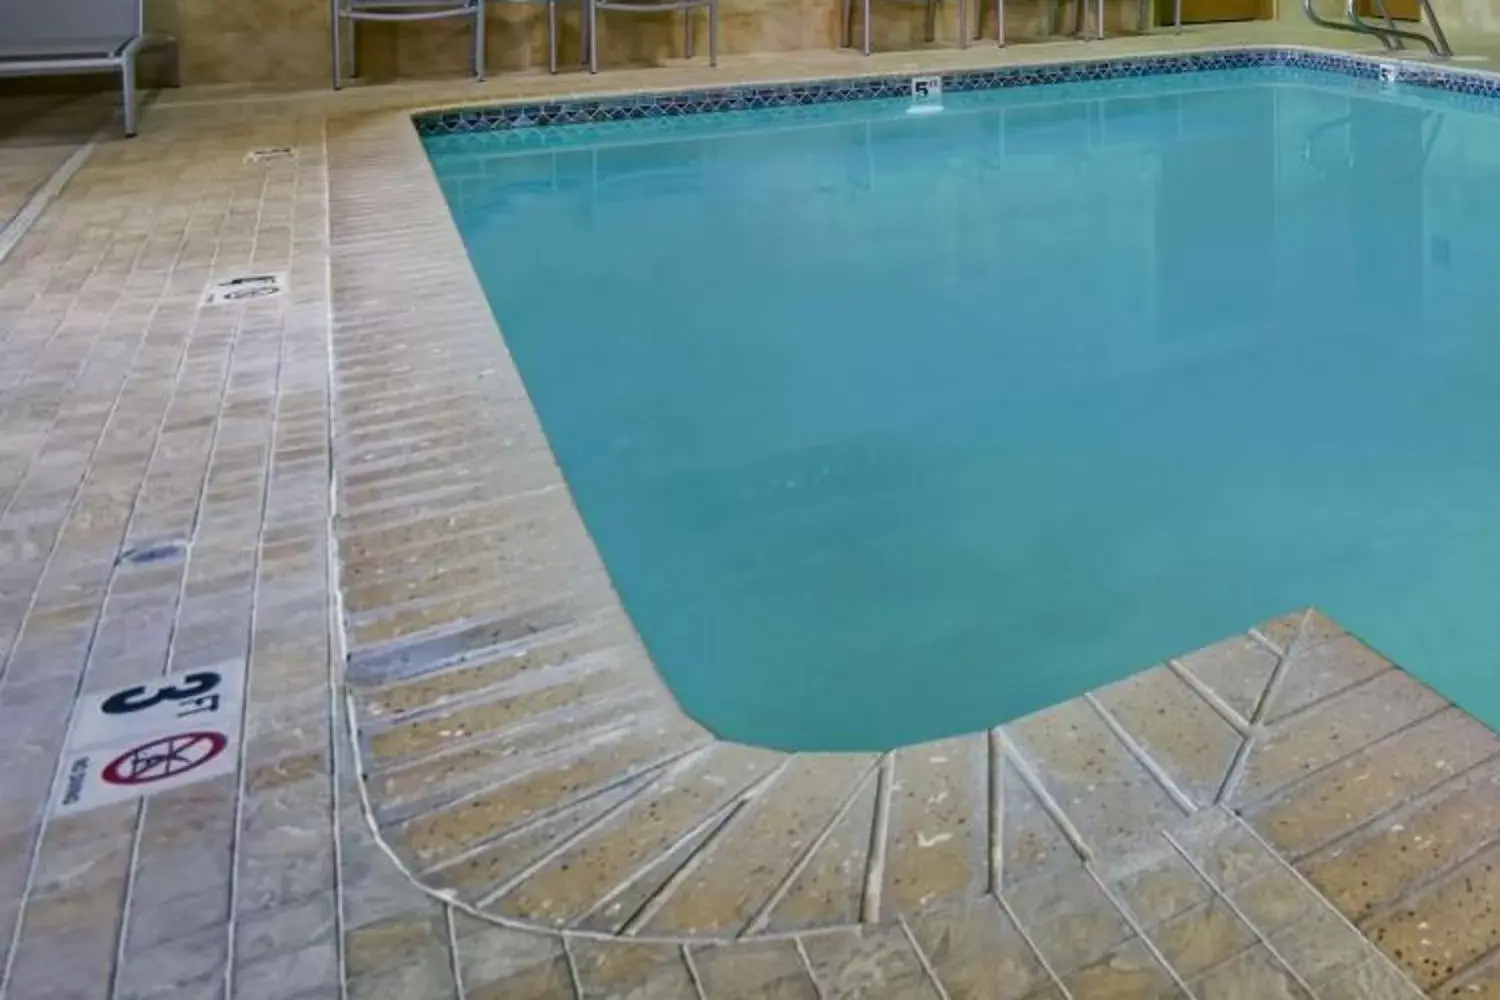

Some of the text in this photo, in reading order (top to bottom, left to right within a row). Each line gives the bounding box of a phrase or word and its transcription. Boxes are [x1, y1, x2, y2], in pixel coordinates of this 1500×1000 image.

[915, 81, 929, 98] 5
[101, 671, 222, 718] 3 FT
